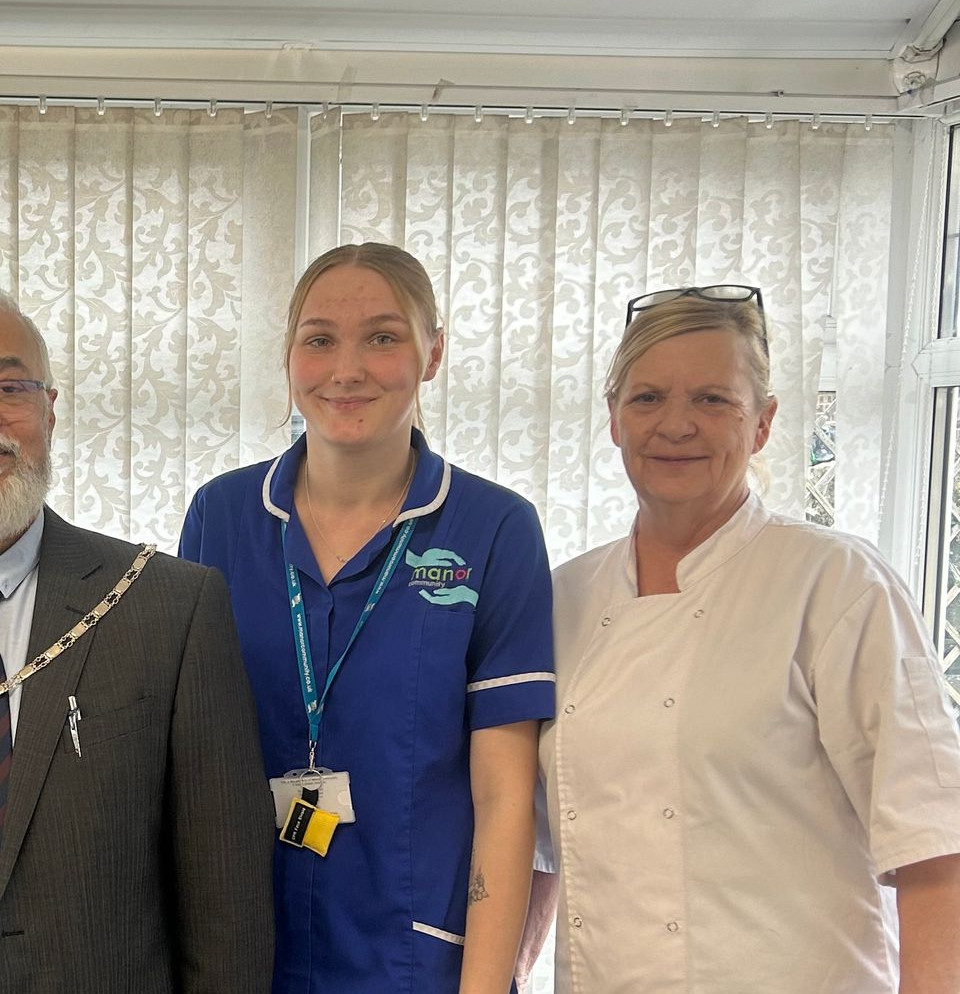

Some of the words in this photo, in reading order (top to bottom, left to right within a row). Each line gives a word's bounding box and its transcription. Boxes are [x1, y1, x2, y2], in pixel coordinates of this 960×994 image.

[411, 567, 472, 582] manor
[408, 580, 445, 588] community
[297, 613, 313, 693] www.manorcommunity.co.uk
